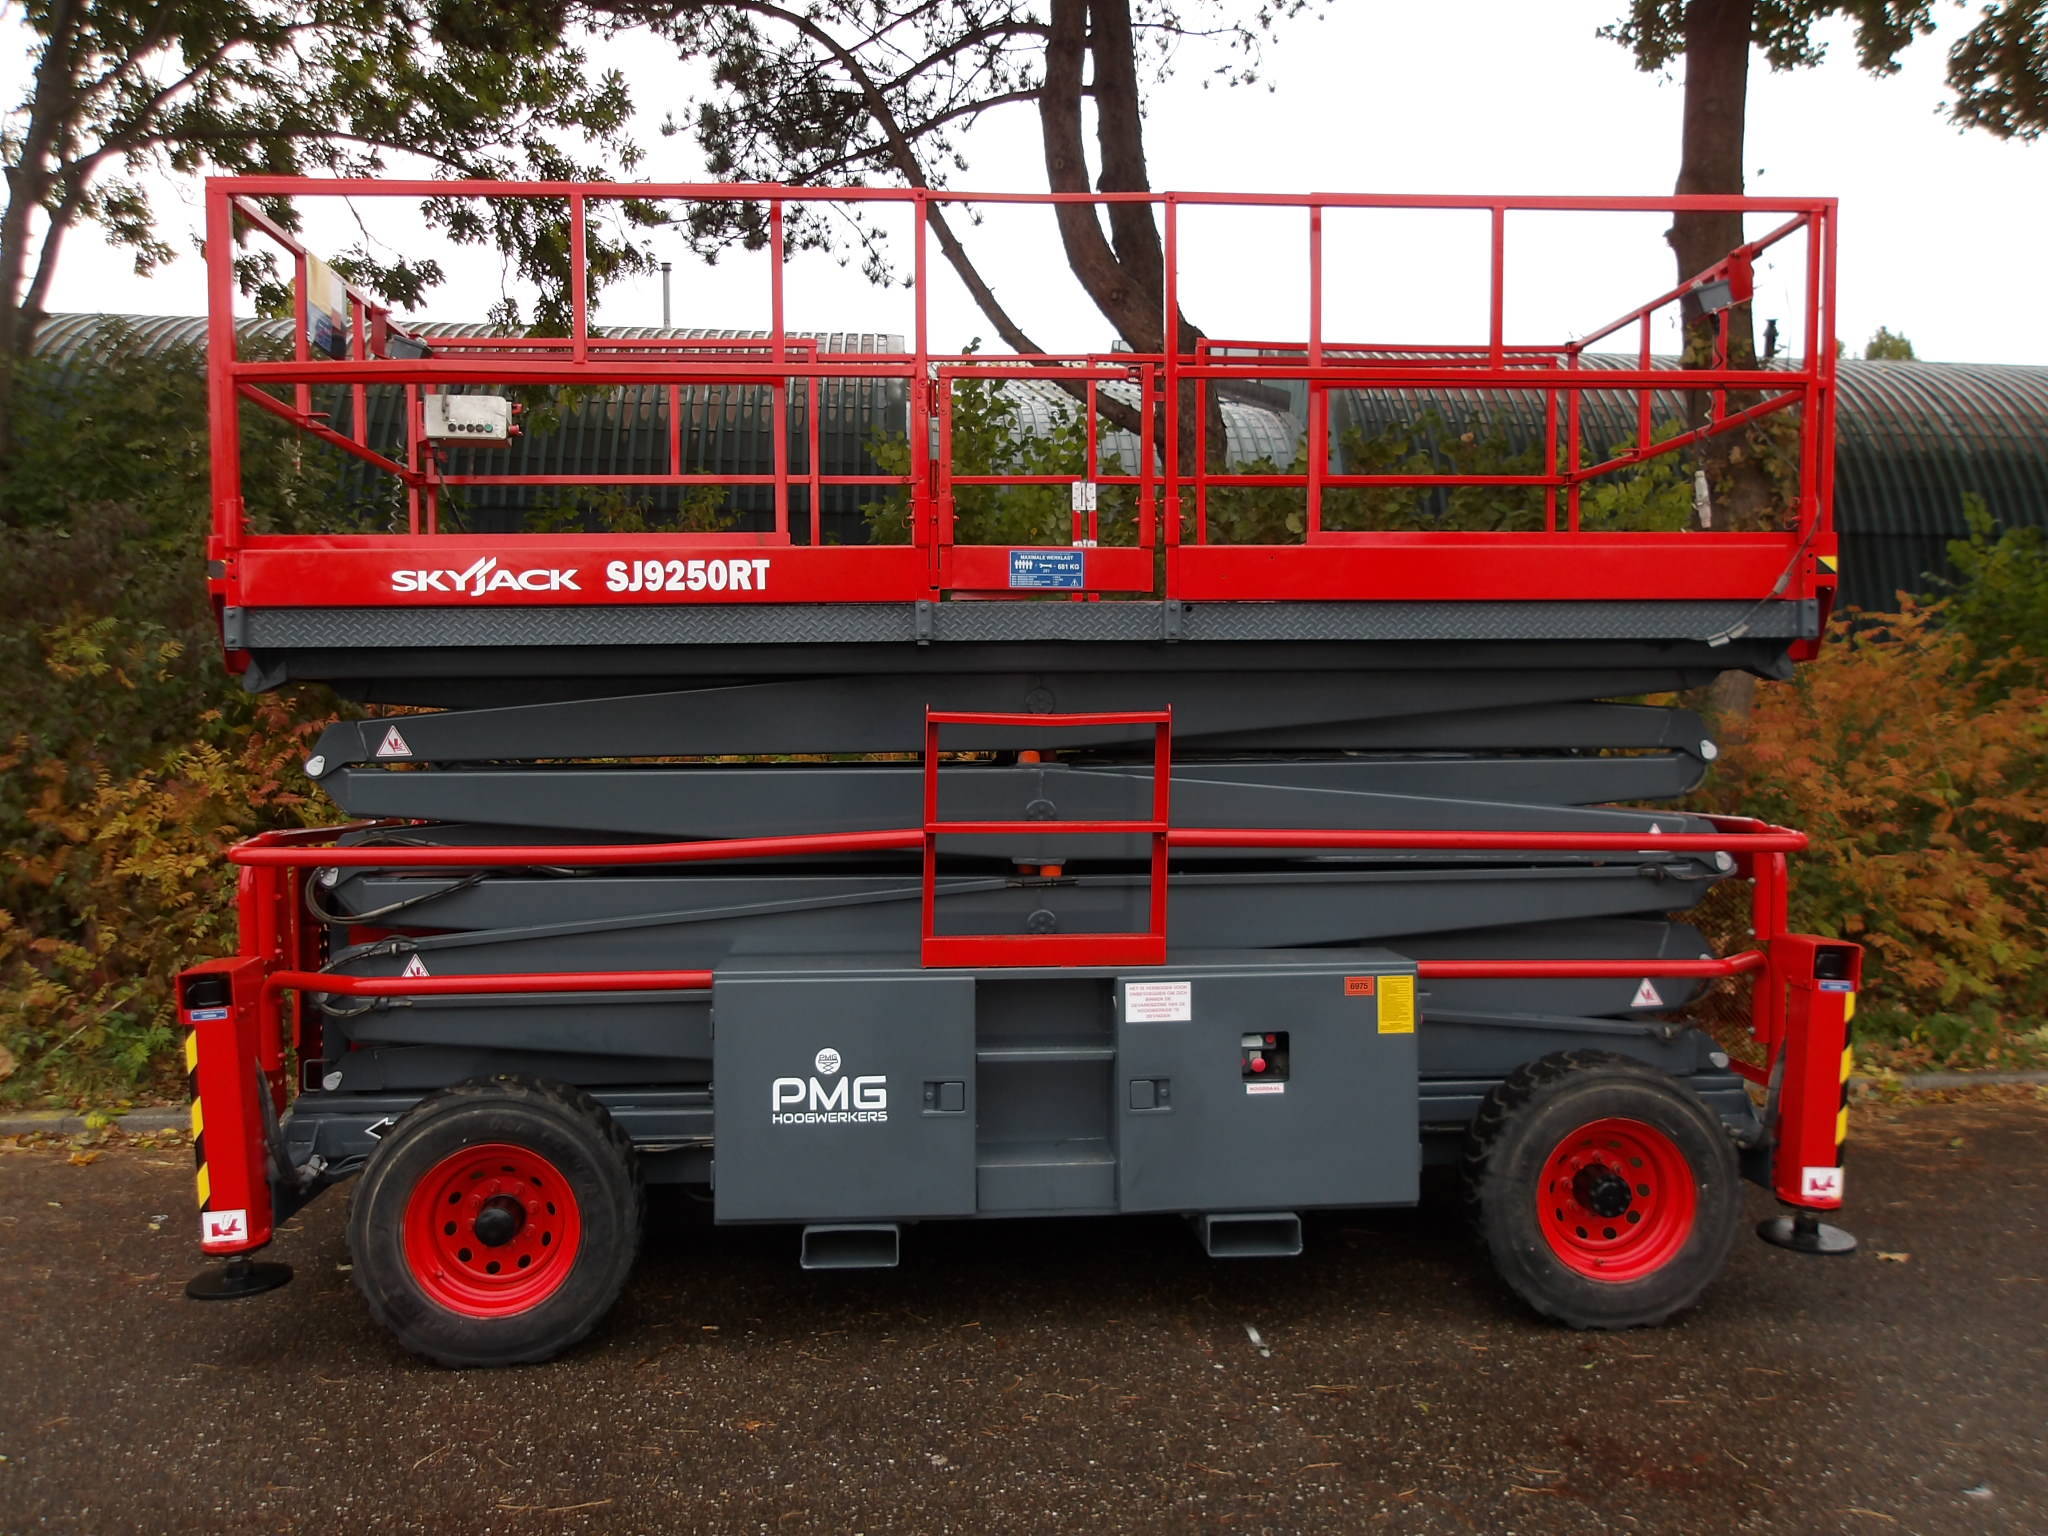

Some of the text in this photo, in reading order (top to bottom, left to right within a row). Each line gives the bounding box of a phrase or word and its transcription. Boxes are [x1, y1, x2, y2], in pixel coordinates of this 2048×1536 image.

[391, 556, 770, 597] SKYJACK SJ9250RT
[818, 1053, 838, 1061] PMG
[773, 1075, 887, 1111] PMG
[772, 1111, 888, 1124] HOOGWERKERS
